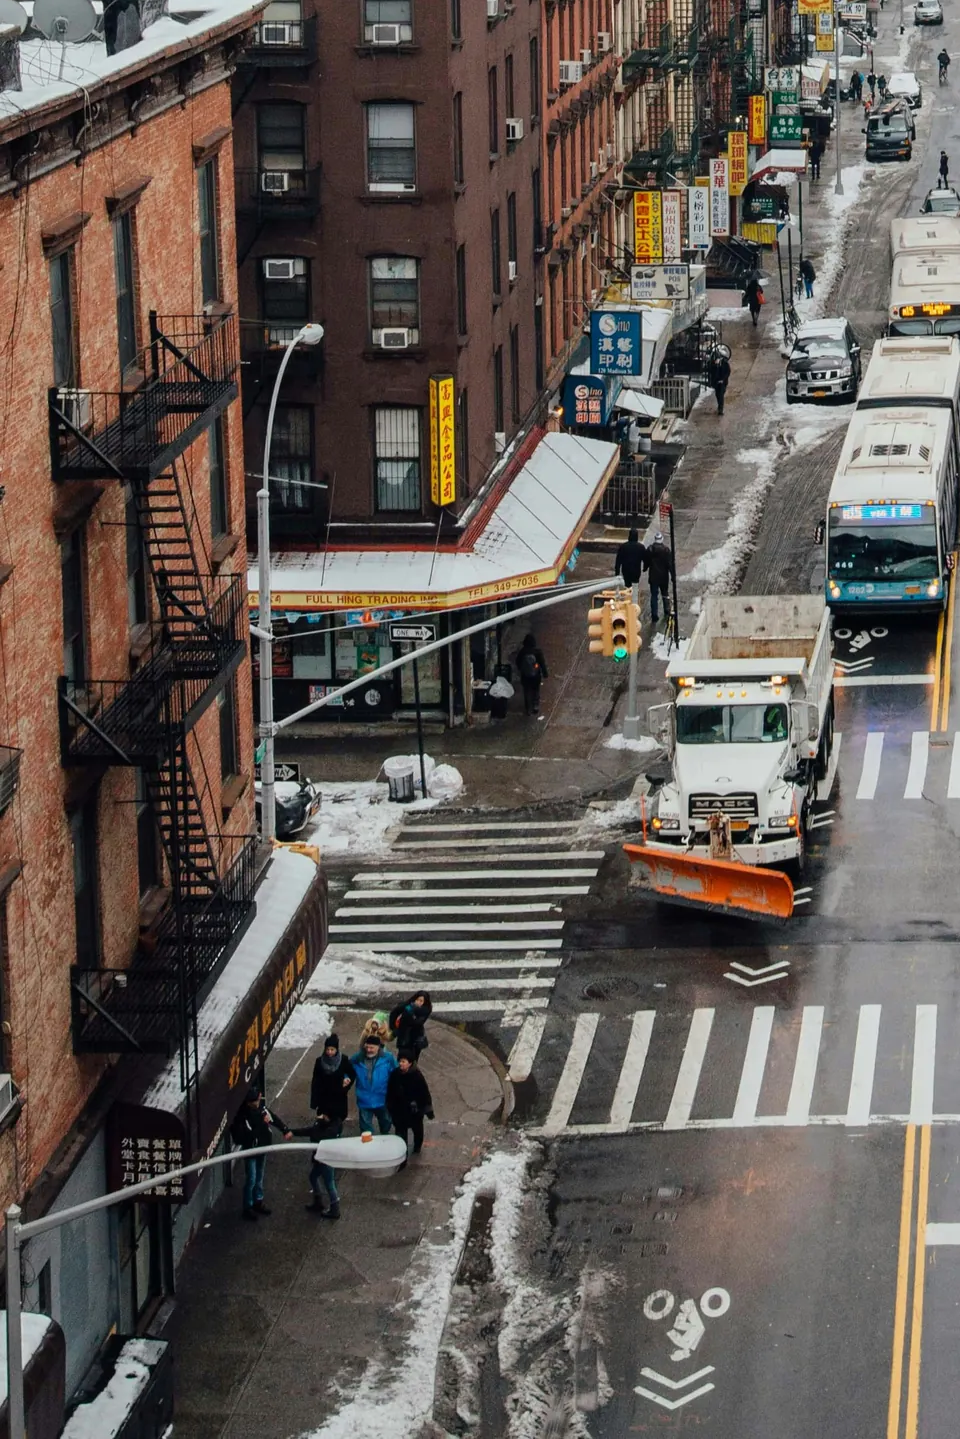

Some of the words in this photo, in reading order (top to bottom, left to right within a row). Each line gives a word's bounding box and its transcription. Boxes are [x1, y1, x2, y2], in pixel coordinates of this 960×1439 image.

[494, 574, 539, 594] 349-7036
[306, 594, 332, 604] FULL
[336, 595, 362, 605] HING
[367, 595, 416, 605] TRADING
[695, 800, 750, 808] MACK
[270, 977, 305, 1045] PRINTING
